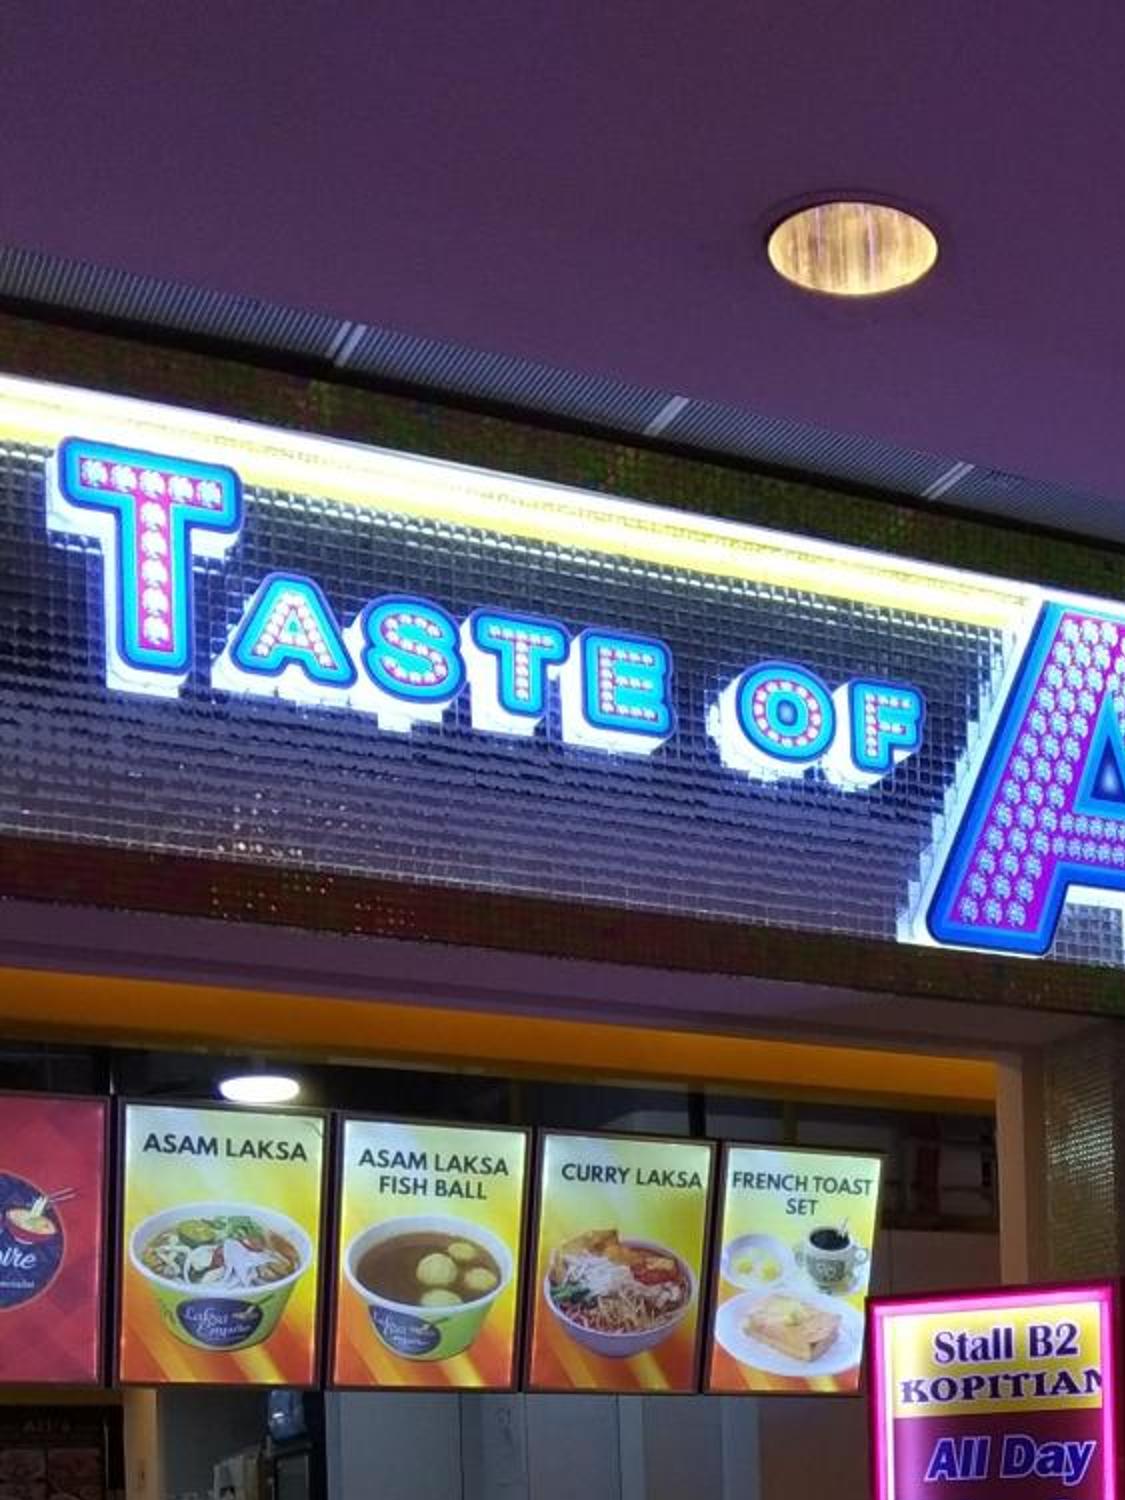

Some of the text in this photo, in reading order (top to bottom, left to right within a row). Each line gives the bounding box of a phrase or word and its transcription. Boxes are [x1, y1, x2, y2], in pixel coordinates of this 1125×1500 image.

[58, 435, 674, 740] TASTE
[735, 659, 927, 774] OF
[143, 1132, 308, 1162] ASAM LAKSA
[358, 1148, 509, 1177] ASAM LAKSA
[561, 1162, 702, 1190] CURRY LAKSA
[379, 1175, 487, 1200] FISH BALL
[732, 1170, 872, 1197] FRENCH TOAST
[786, 1198, 819, 1217] SET
[934, 1323, 1079, 1365] Stall B2
[925, 1433, 1096, 1486] All Day
